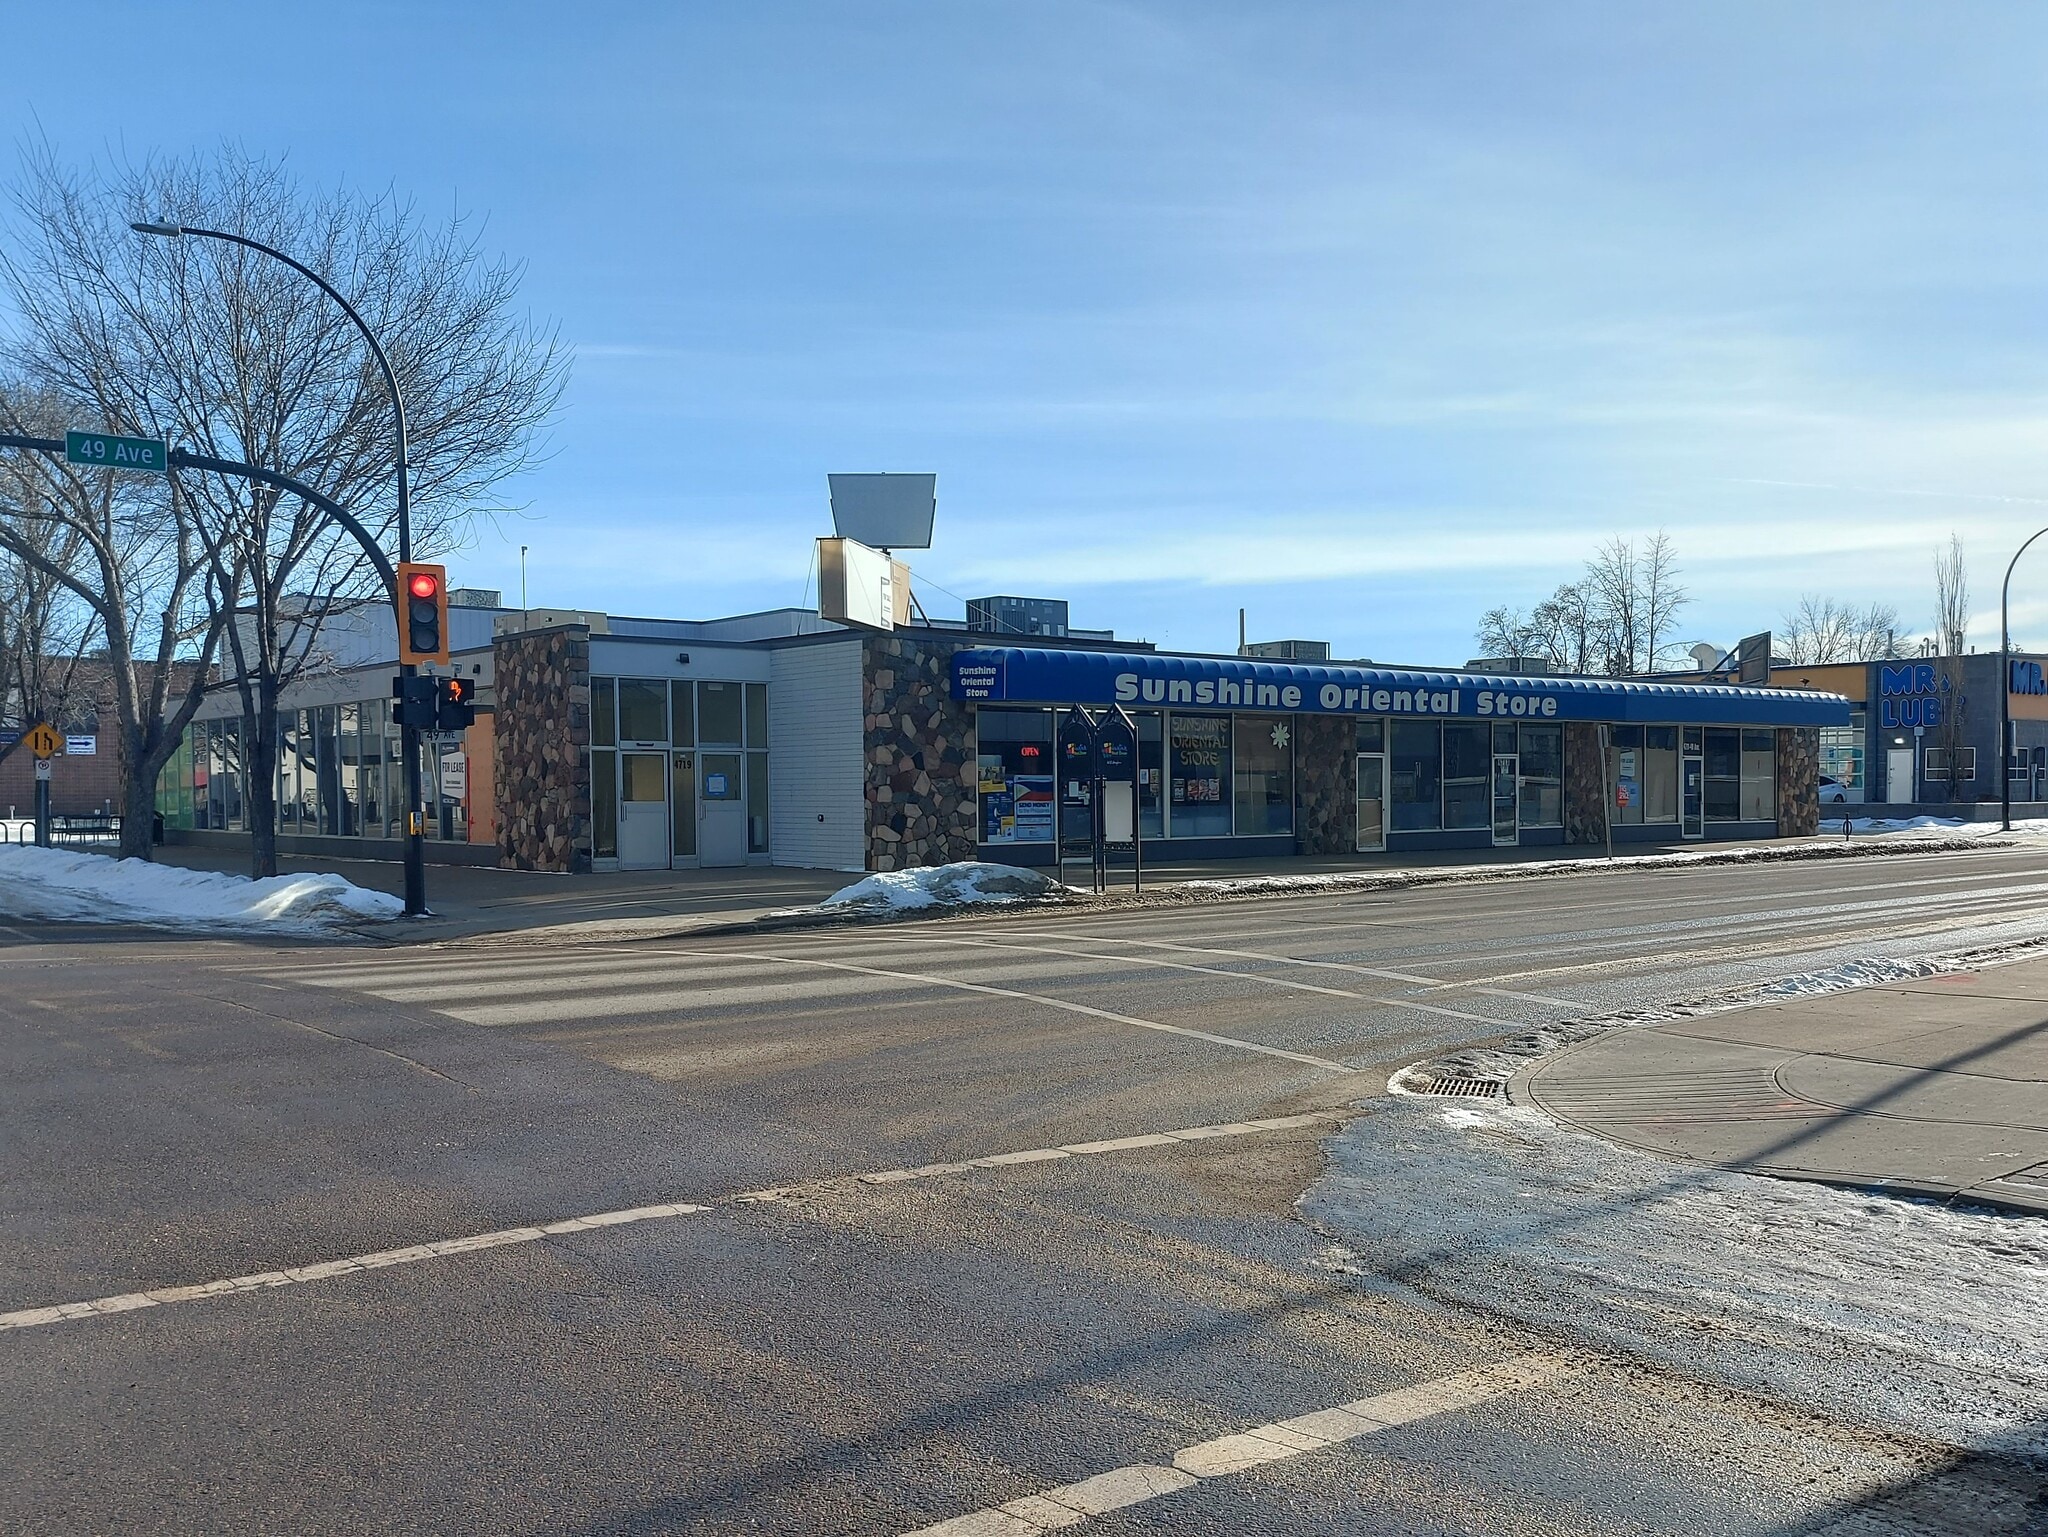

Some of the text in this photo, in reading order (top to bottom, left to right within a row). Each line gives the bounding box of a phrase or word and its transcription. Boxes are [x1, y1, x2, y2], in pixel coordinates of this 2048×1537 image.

[80, 439, 153, 464] 49 Ave
[959, 666, 997, 675] Sunshine
[960, 677, 995, 686] Oriental
[965, 688, 989, 697] Store
[1114, 673, 1557, 716] Sunshine Oriental Store
[1172, 717, 1228, 732] SUNSHINE
[426, 729, 440, 741] 49
[1172, 733, 1228, 749] ORIENTAL
[1021, 747, 1039, 757] OPEN
[1180, 750, 1220, 767] STORE
[442, 762, 465, 773] FOR LEASE
[675, 760, 692, 770] 4719
